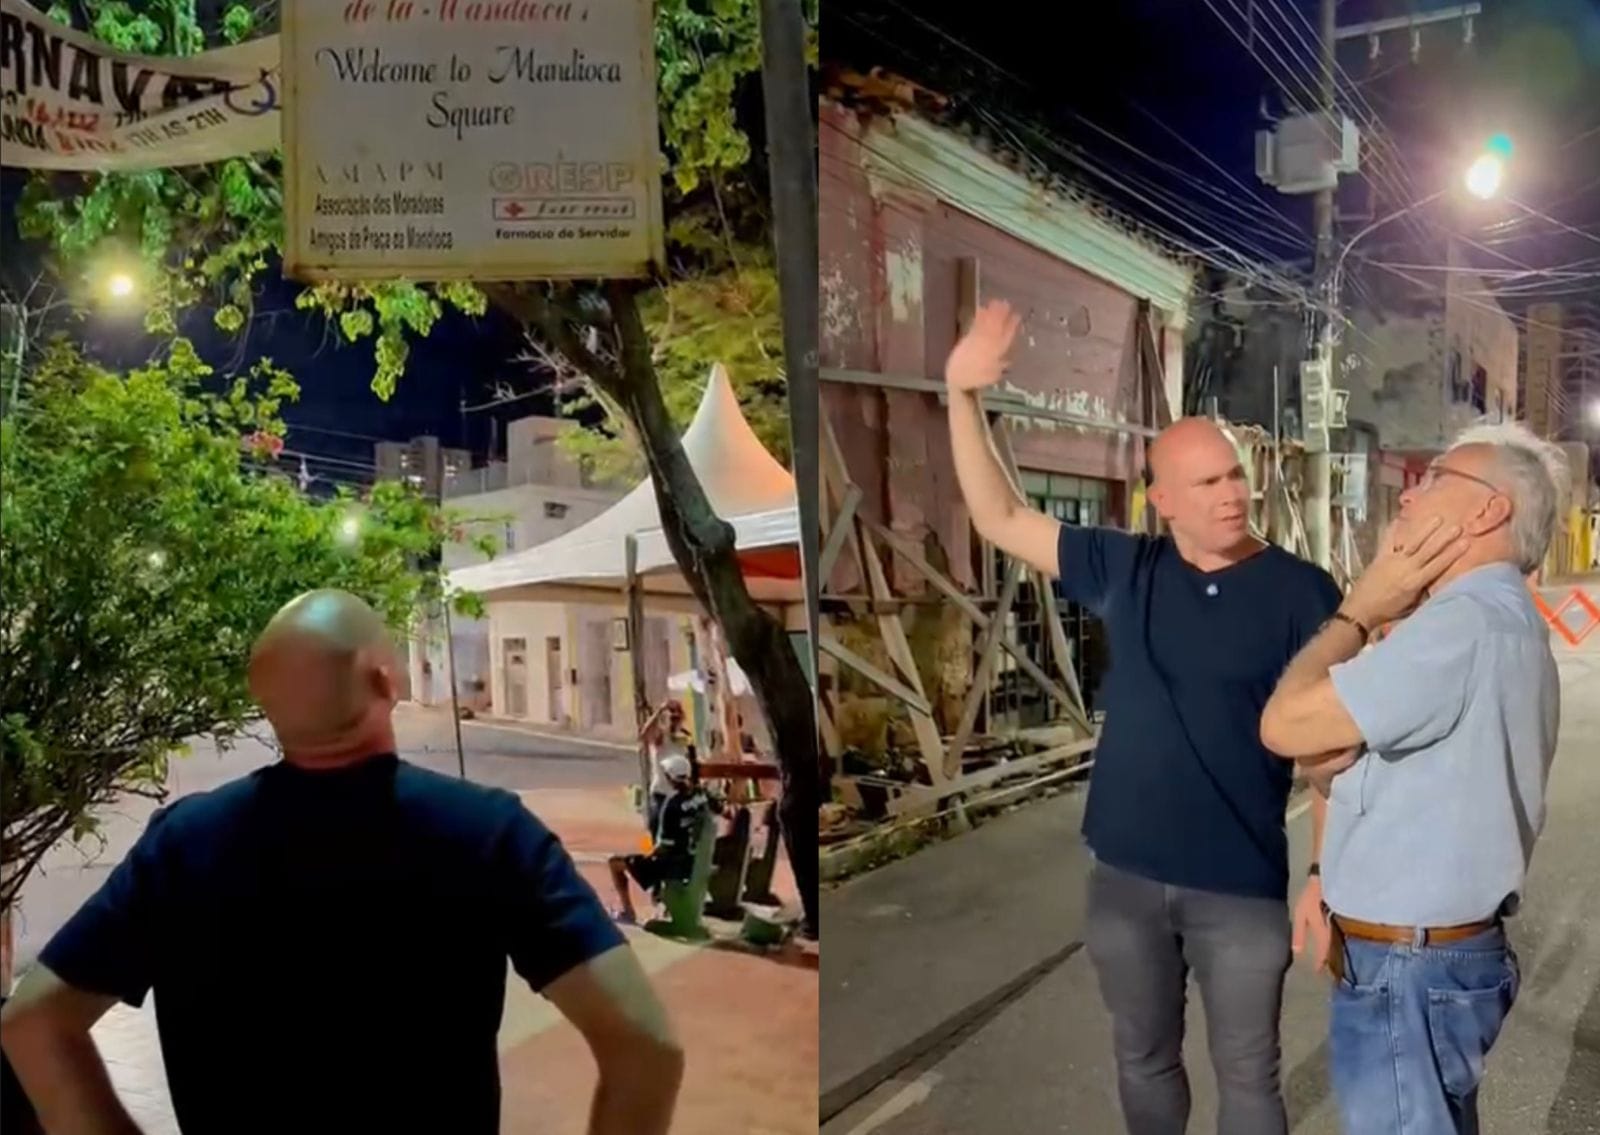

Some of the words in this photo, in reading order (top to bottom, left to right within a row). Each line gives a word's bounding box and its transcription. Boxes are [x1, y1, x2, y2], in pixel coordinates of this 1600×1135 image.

[315, 47, 437, 83] Welcome
[450, 54, 471, 83] to
[488, 46, 621, 83] Mandioca
[427, 92, 515, 139] Square
